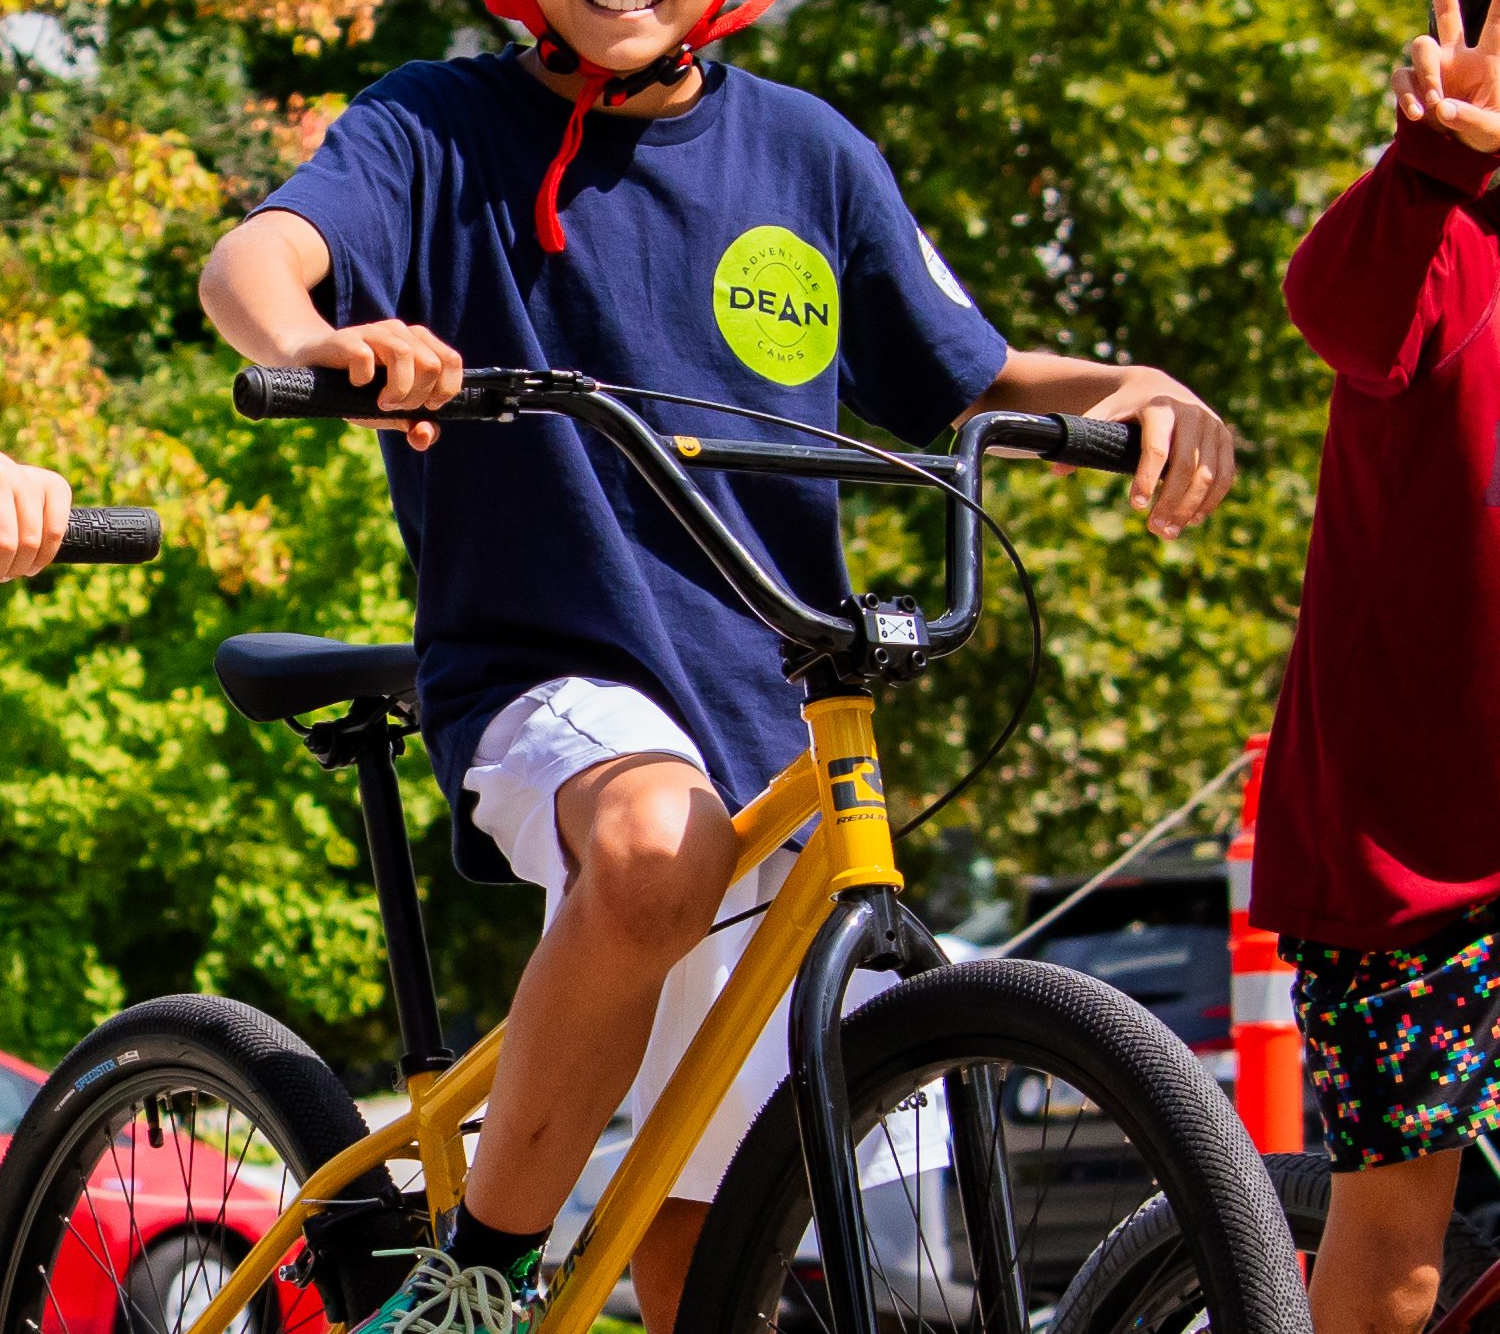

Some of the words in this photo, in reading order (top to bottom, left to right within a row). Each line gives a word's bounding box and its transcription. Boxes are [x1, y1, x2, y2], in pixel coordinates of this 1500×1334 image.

[742, 247, 821, 293] ADVENTURE
[729, 286, 828, 327] DEAN
[757, 340, 804, 363] CAMPS
